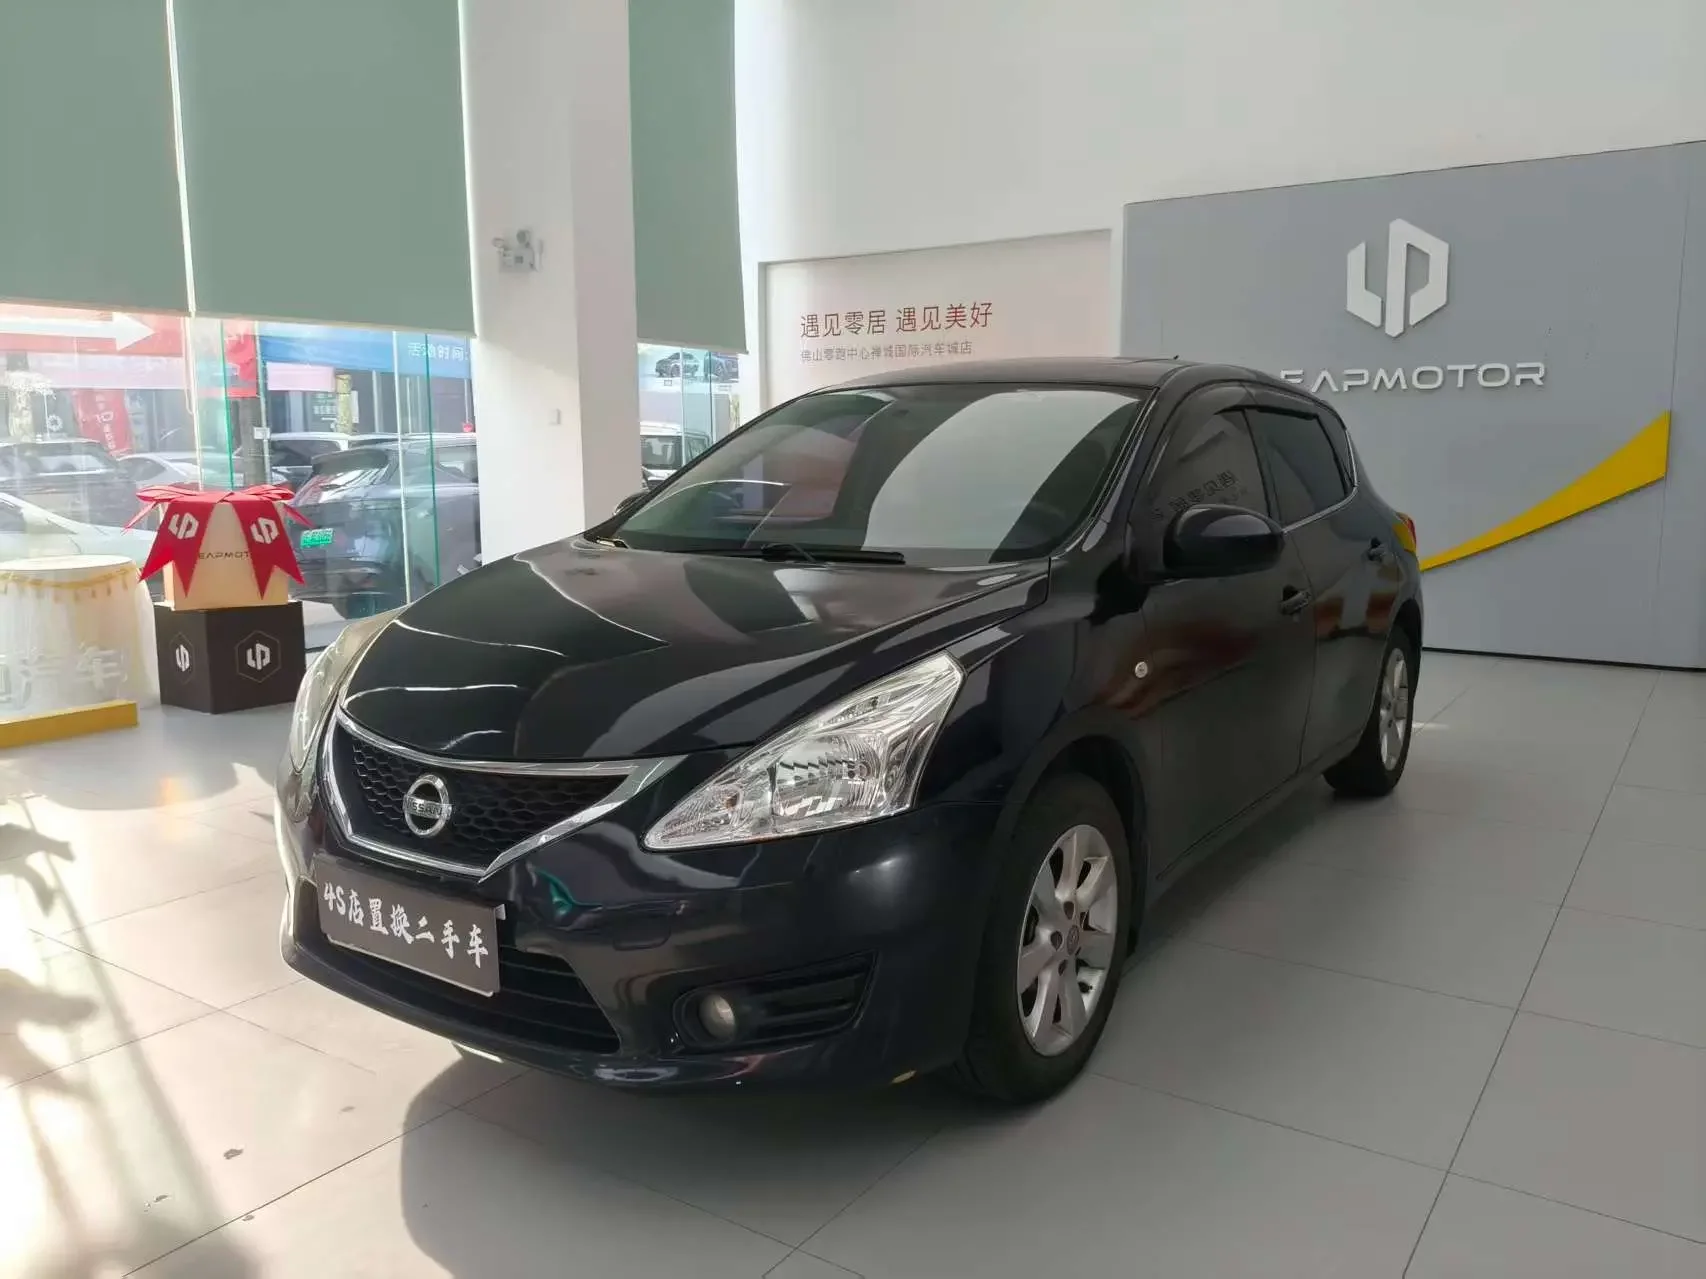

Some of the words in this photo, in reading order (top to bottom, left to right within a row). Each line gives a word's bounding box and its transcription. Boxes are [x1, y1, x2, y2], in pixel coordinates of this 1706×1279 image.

[800, 309, 886, 339] 遇见零居
[895, 302, 993, 334] 遇见美好
[1279, 362, 1545, 393] EAPMOTOR
[199, 551, 250, 559] EAPMOT
[323, 882, 488, 969] 4S店置换二手车
